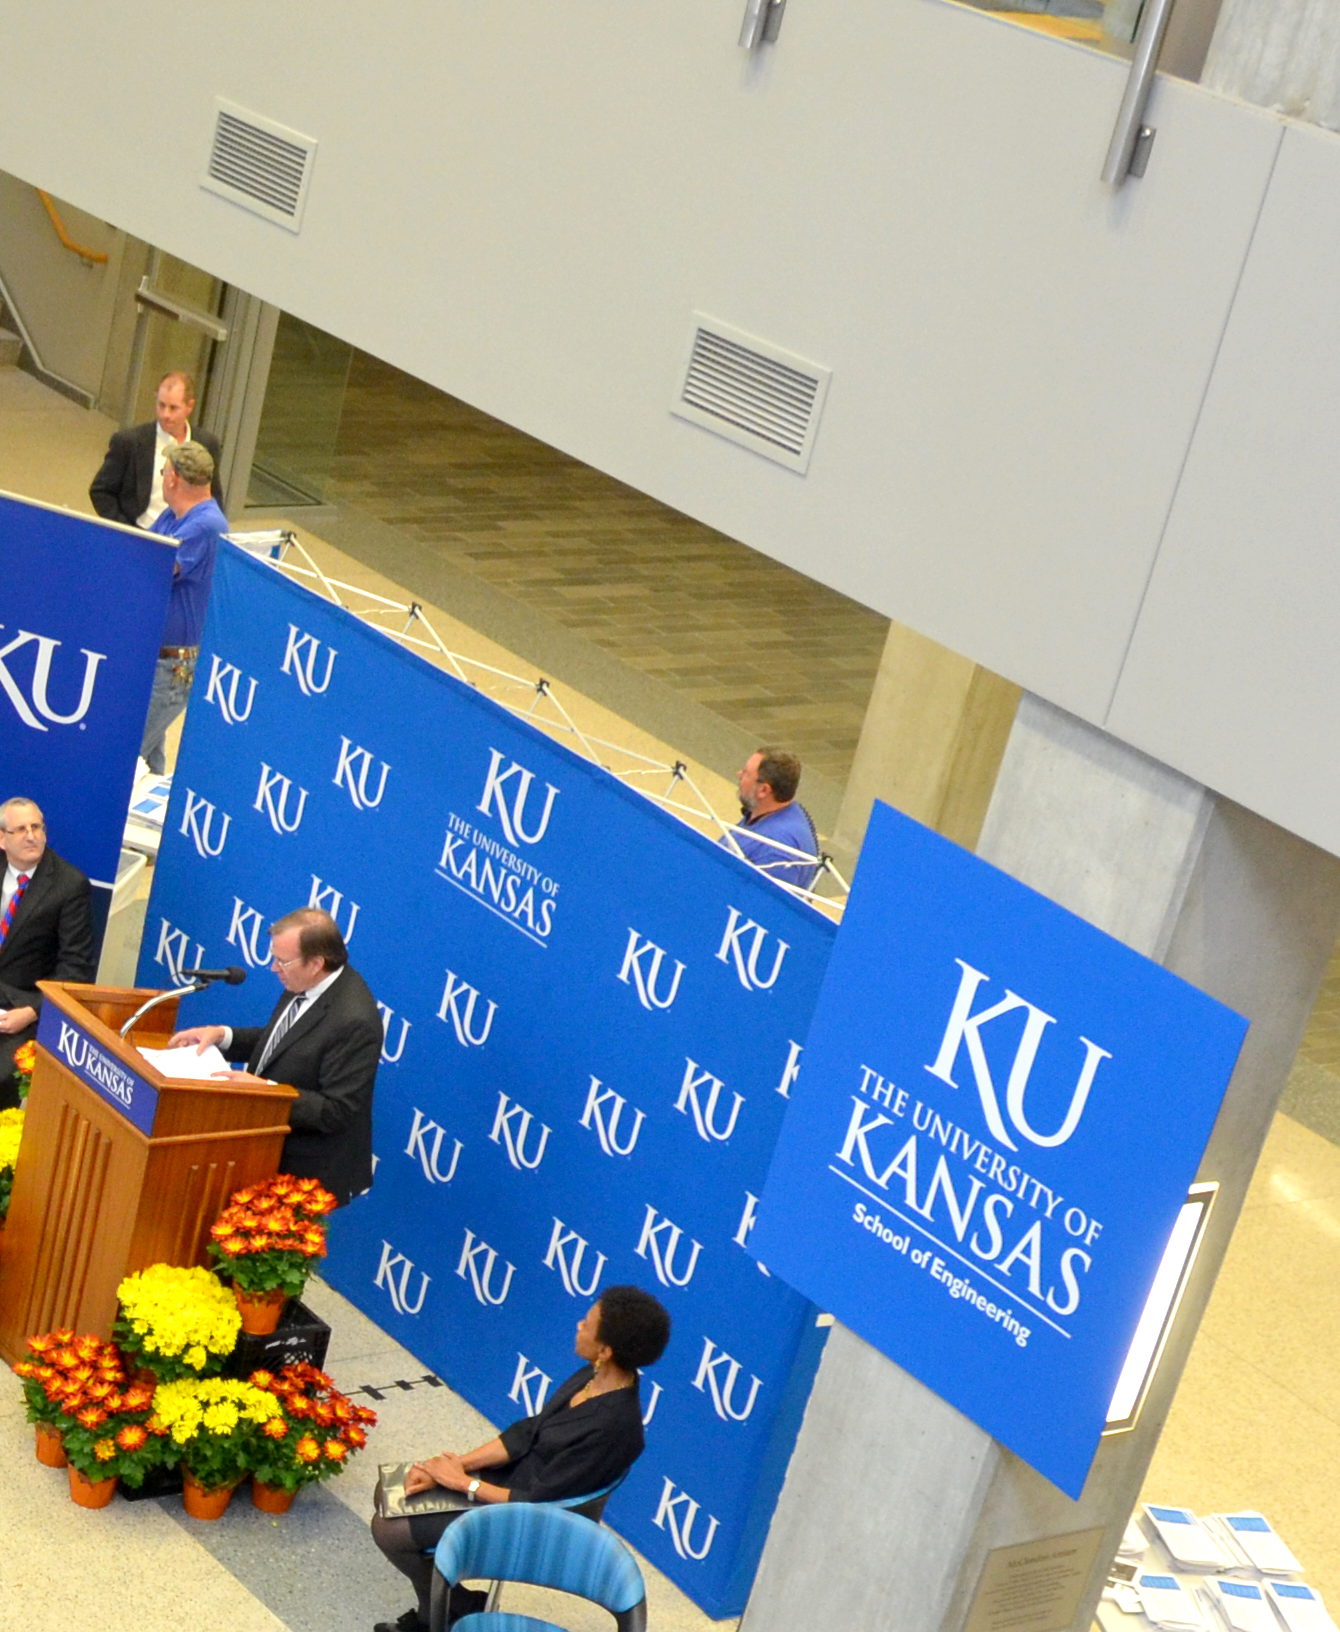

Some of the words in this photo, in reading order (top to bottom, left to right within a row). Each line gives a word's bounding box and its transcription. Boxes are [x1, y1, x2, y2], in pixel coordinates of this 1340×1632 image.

[205, 654, 258, 724] KU
[281, 624, 337, 696] KU
[254, 763, 308, 834] KU
[333, 736, 390, 810] KU
[476, 747, 561, 848] KU
[180, 788, 231, 858] KU
[449, 812, 472, 840] THE
[472, 828, 542, 885] UNIVERSITY
[541, 876, 561, 898] OF
[438, 829, 557, 938] KANSAS
[154, 917, 206, 987] KU
[617, 928, 686, 1010] KU
[716, 906, 789, 990] KU
[57, 1020, 90, 1068] KU
[437, 970, 497, 1046] KU
[85, 1051, 134, 1106] KANSAS
[924, 957, 1113, 1153] KU
[489, 1092, 551, 1169] KU
[579, 1076, 645, 1156] KU
[674, 1058, 745, 1141] KU
[405, 1109, 462, 1182] KU
[859, 1063, 910, 1119] THE
[911, 1100, 1065, 1220] UNIVERSITY
[1063, 1206, 1104, 1247] OF
[635, 1204, 702, 1286] KU
[834, 1094, 1093, 1317] KANSAS
[375, 1241, 430, 1313] KU
[457, 1230, 516, 1304] KU
[543, 1218, 607, 1296] KU
[851, 1202, 911, 1255] School
[910, 1248, 932, 1270] of
[929, 1255, 1032, 1348] Engineering
[692, 1337, 762, 1420] KU
[653, 1477, 719, 1559] KU
